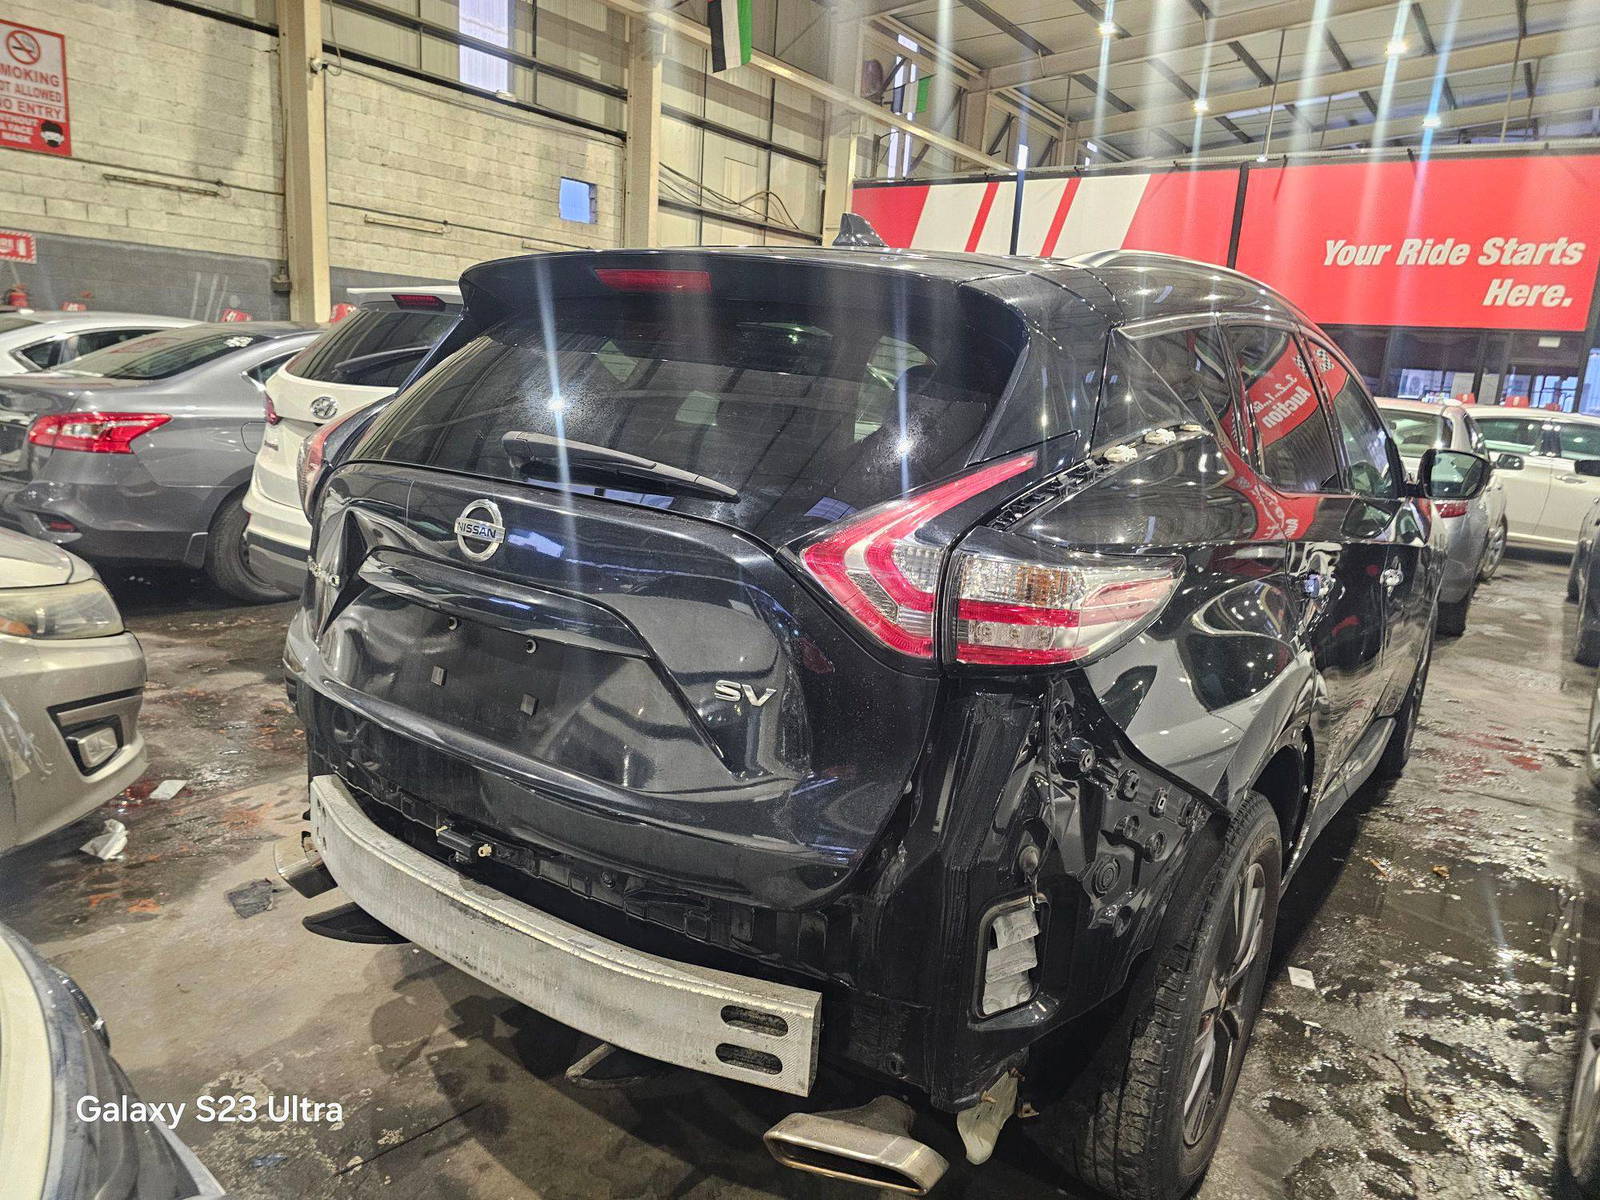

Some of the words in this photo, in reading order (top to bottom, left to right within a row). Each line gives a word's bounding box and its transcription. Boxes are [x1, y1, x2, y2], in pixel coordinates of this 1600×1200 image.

[0, 63, 60, 87] MOKING
[0, 80, 10, 90] OT
[15, 84, 62, 103] ALLOWED
[0, 98, 12, 110] O
[18, 101, 62, 120] ENTRY
[1324, 240, 1391, 265] Your
[1396, 238, 1470, 265] Ride
[1478, 237, 1586, 265] Starts
[1483, 279, 1573, 307] Here.
[458, 521, 496, 539] NISSAN
[714, 680, 777, 706] SV
